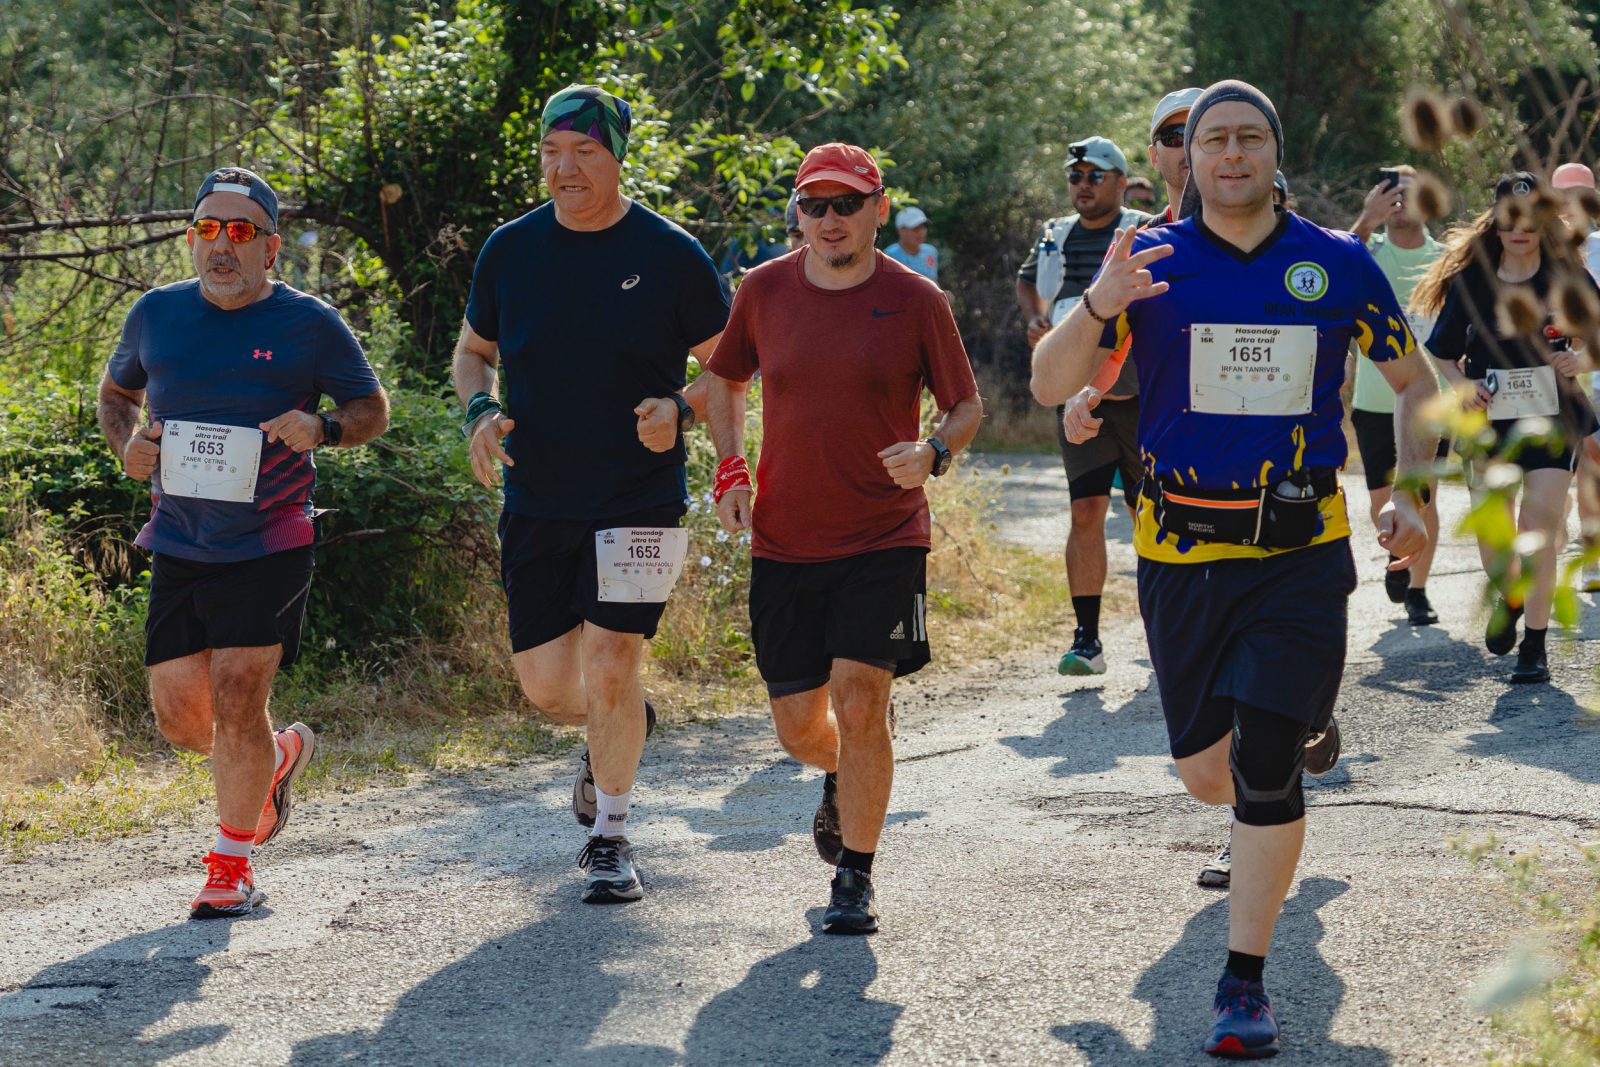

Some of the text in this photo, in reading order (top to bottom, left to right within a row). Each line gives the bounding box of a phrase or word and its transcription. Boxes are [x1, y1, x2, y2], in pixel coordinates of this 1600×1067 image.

[1235, 327, 1280, 336] Hasandağı
[1229, 346, 1272, 362] 1651
[1507, 380, 1532, 390] 1643
[189, 440, 224, 455] 1653
[183, 455, 202, 463] TANER
[627, 545, 660, 559] 1652
